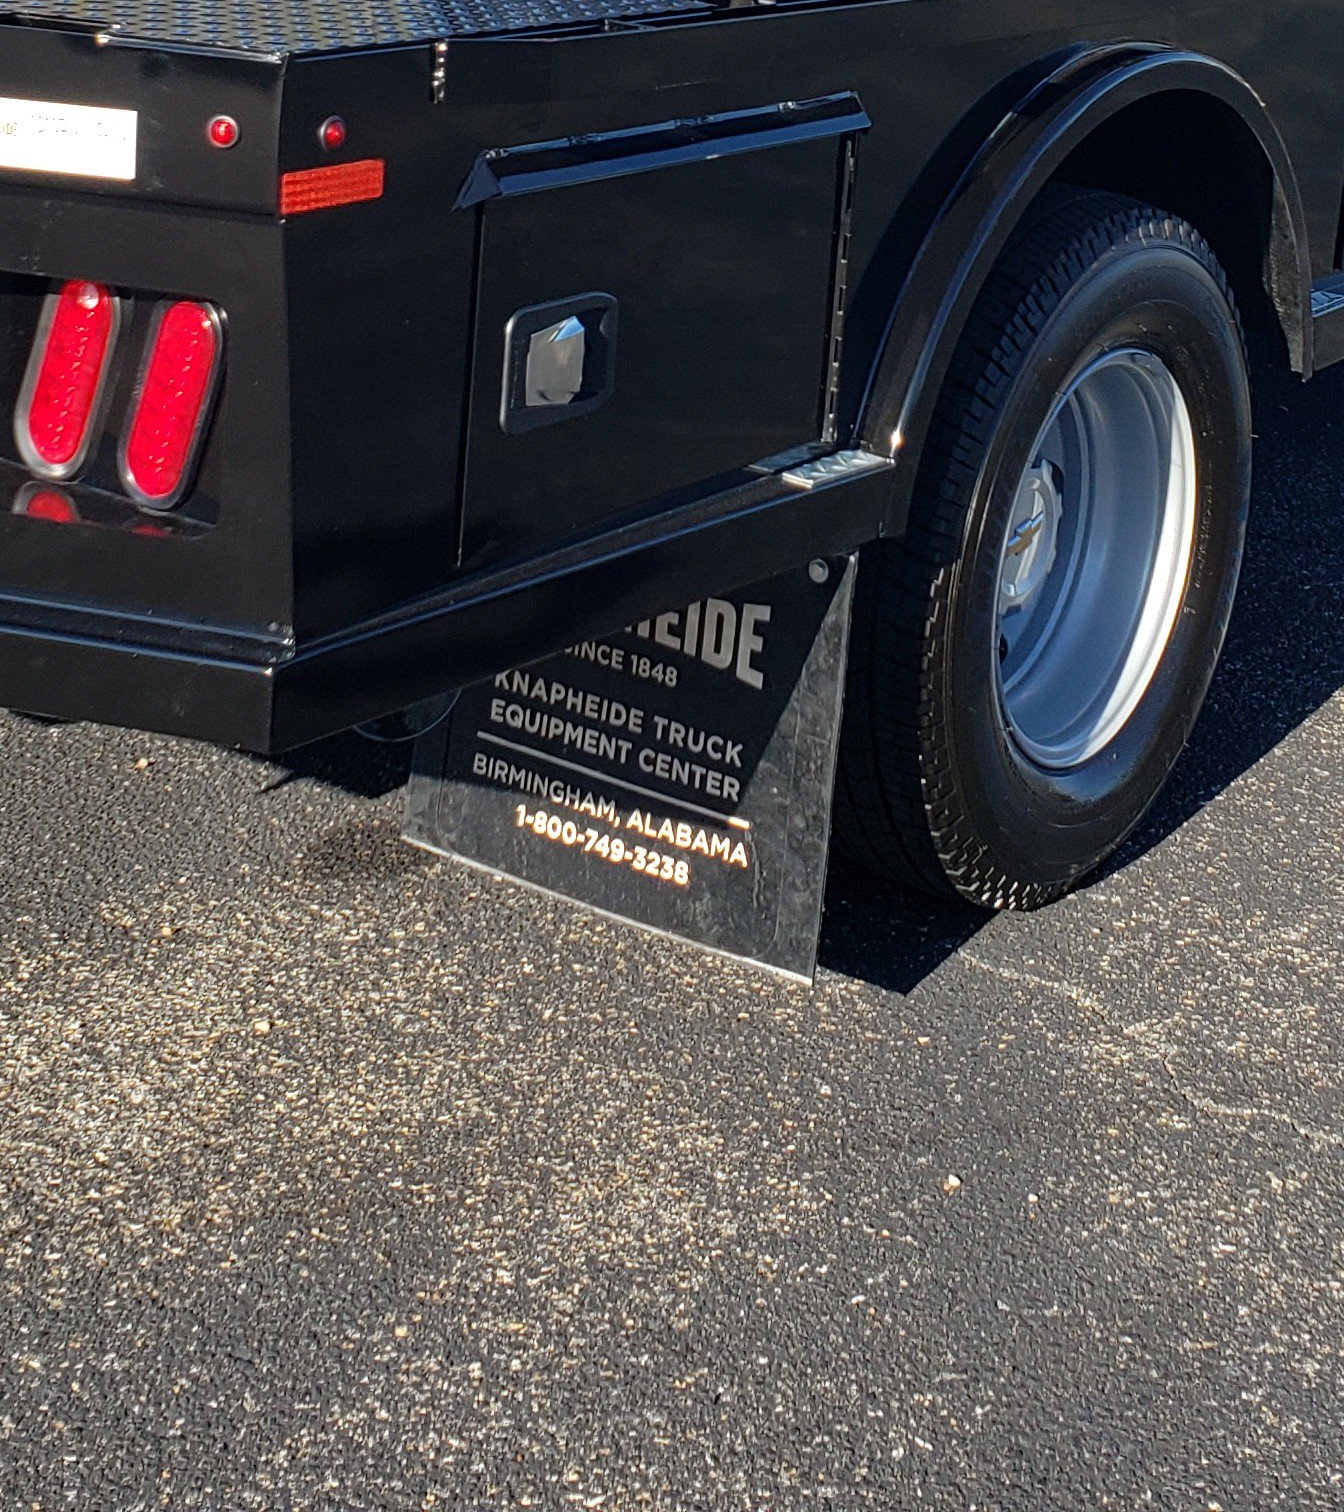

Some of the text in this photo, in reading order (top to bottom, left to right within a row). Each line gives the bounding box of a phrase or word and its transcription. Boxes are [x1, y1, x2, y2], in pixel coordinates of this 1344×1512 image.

[494, 668, 744, 768] KNAPHEIDE TRUCK
[630, 654, 678, 688] 1848
[490, 698, 742, 803] EQUIPMENT CENTER
[472, 753, 748, 869] BIRMINGHAM, ALABAMA
[515, 804, 690, 887] 1-800-749-3238
